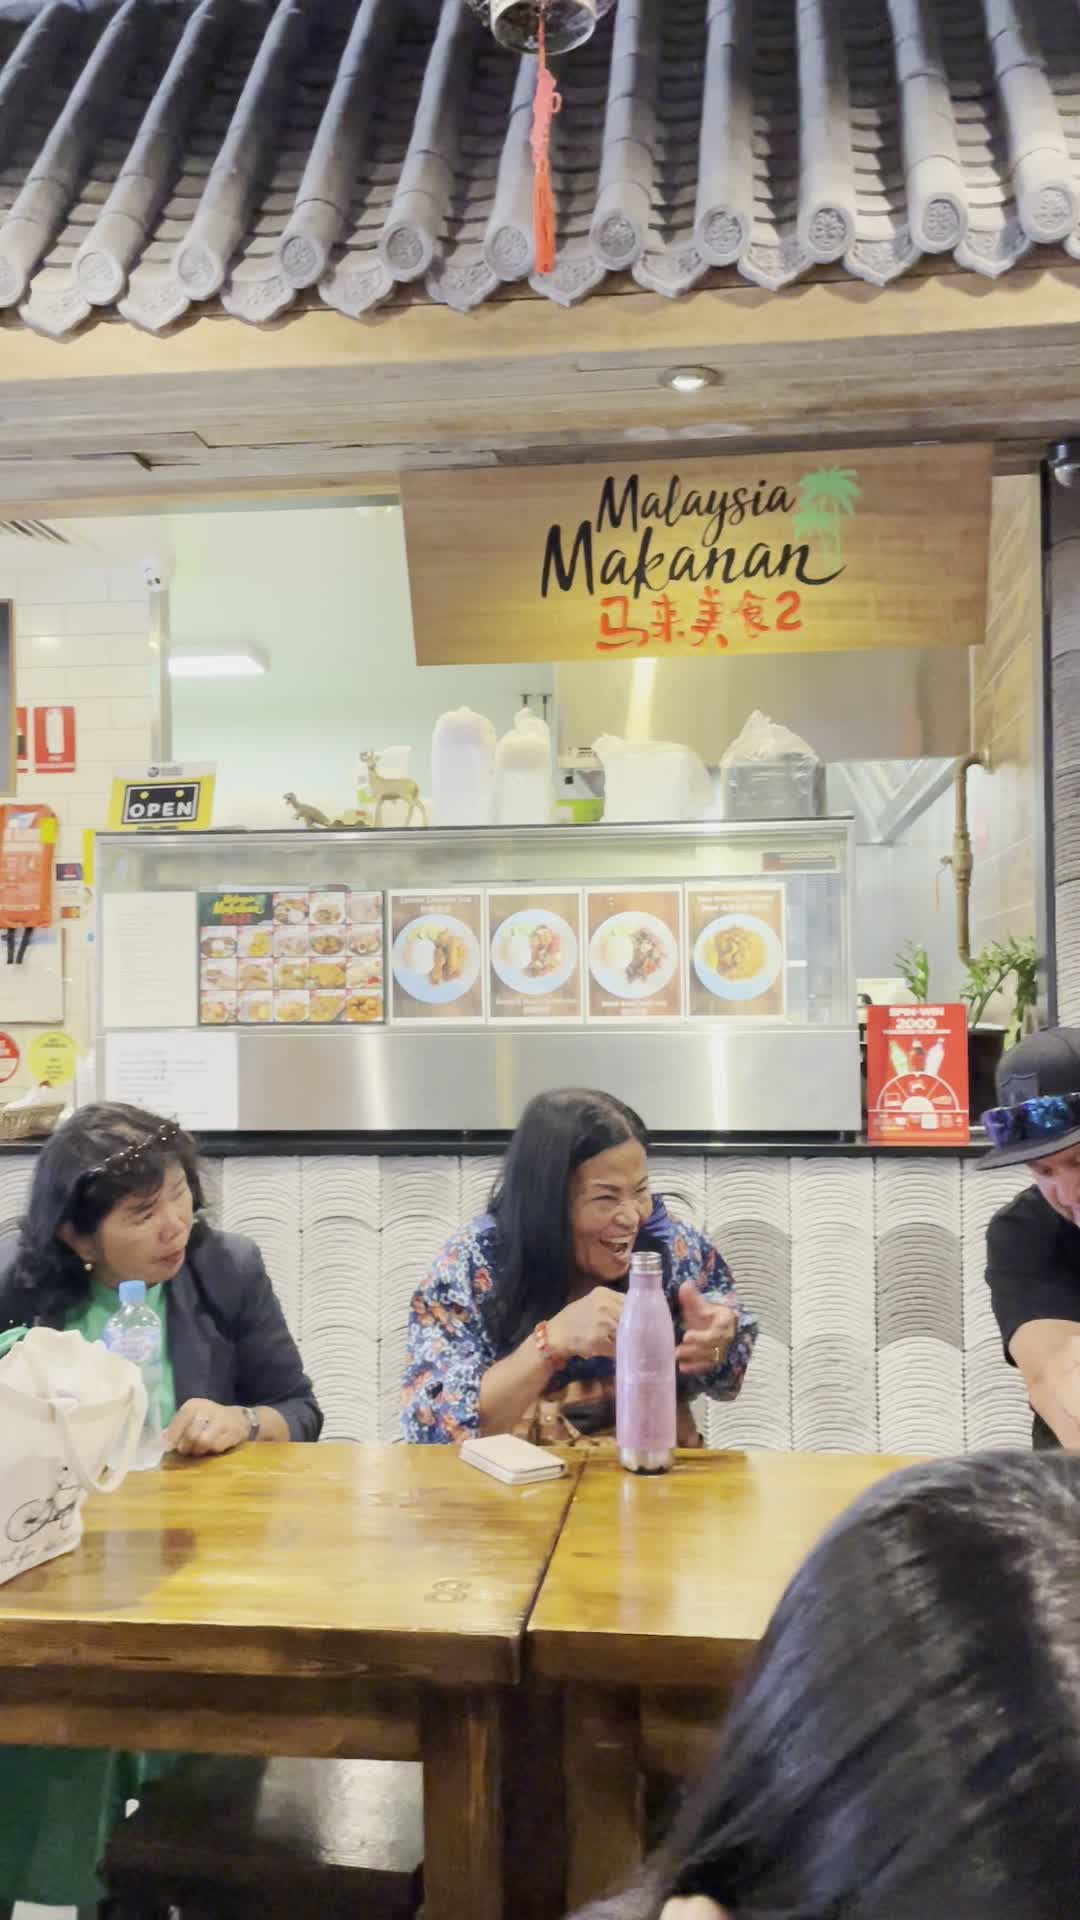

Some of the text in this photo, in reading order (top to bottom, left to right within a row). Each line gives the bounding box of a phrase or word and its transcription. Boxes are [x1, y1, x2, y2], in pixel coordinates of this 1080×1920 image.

[597, 474, 797, 547] Malaysia
[541, 520, 846, 598] Makanan
[129, 801, 192, 818] OPEN
